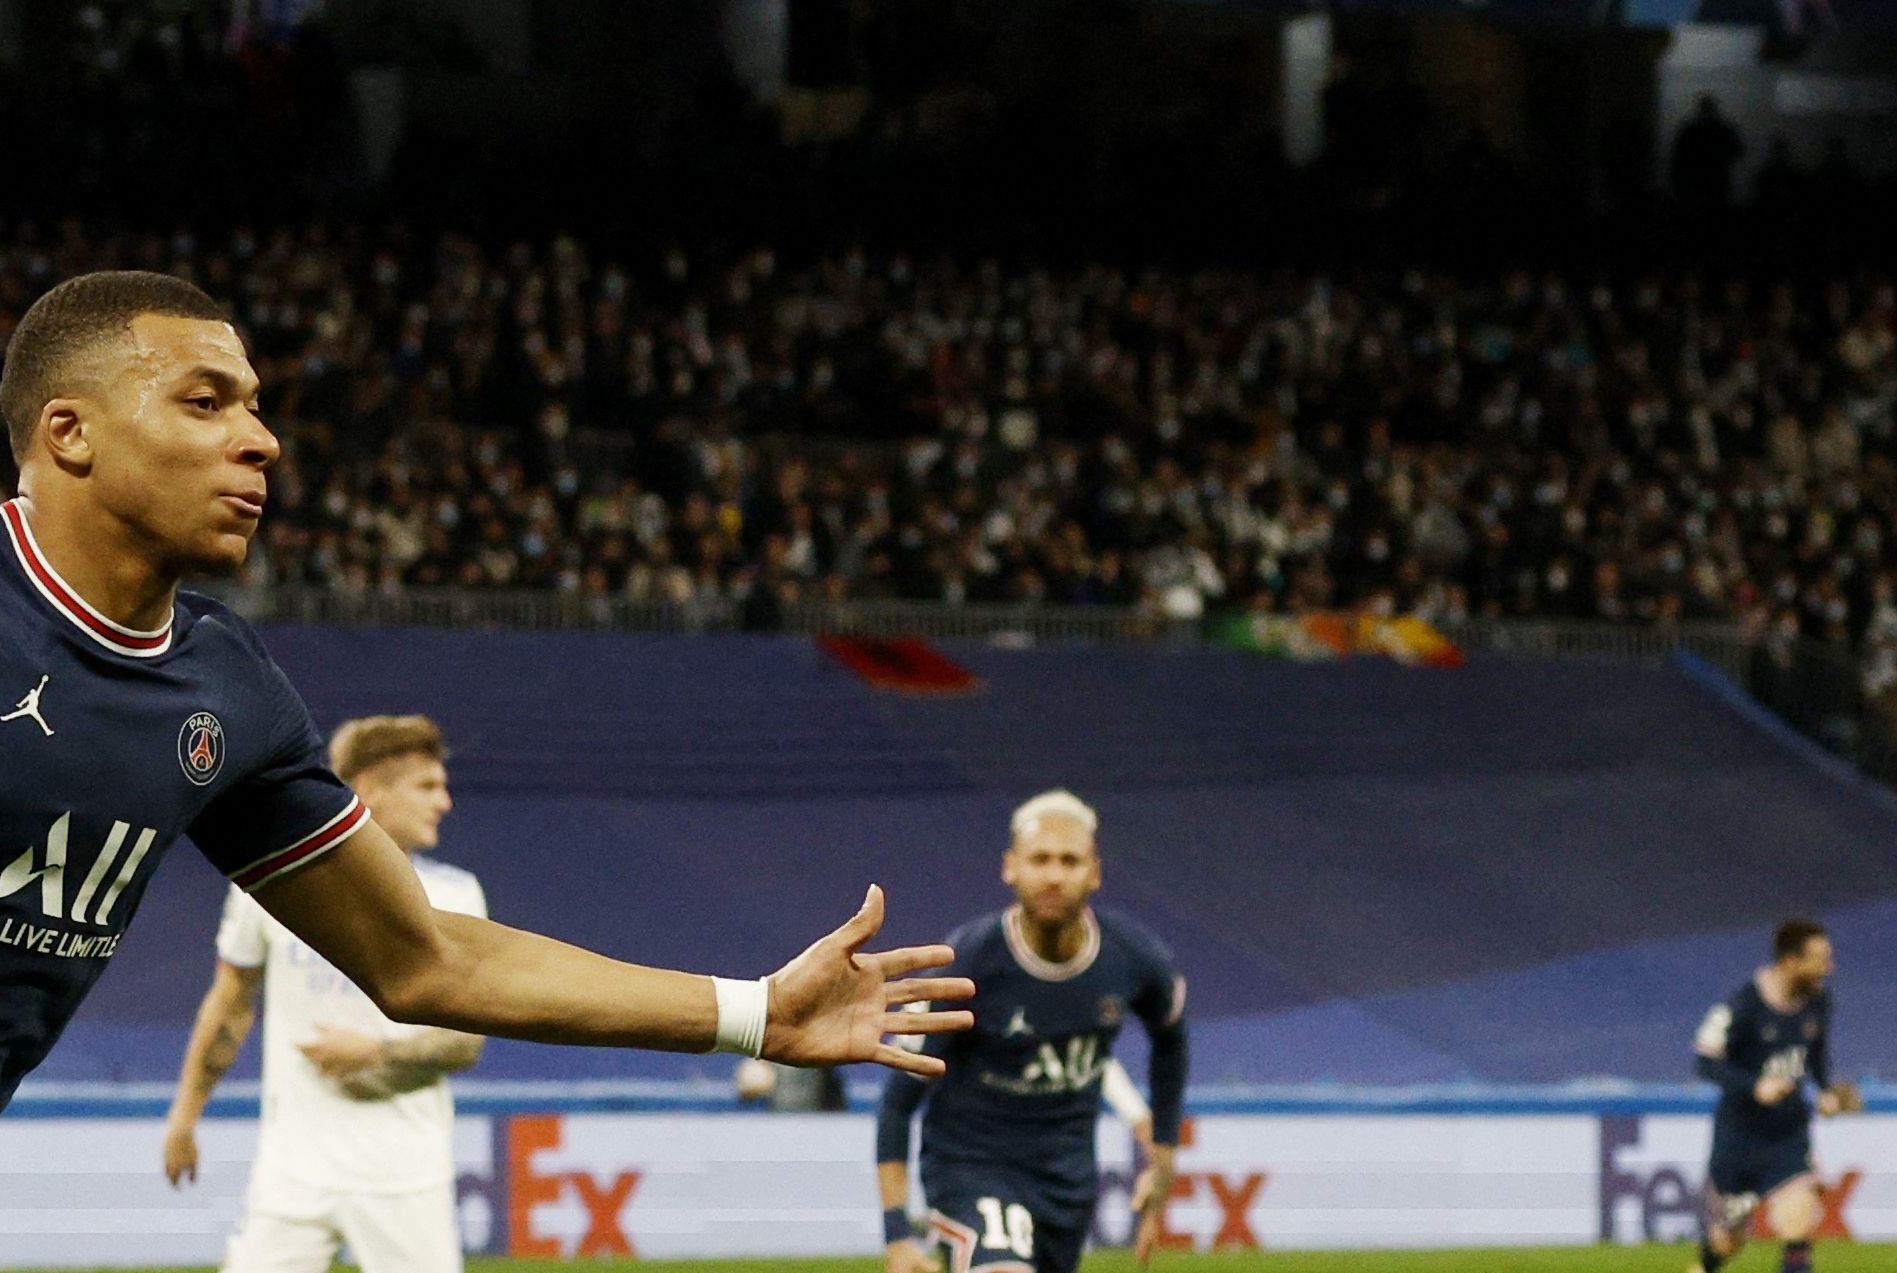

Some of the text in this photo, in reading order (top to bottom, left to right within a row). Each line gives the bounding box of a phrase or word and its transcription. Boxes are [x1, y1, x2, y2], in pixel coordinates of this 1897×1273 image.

[189, 716, 221, 738] PARIS
[455, 1113, 642, 1258] dEx
[976, 1197, 1033, 1258] 10
